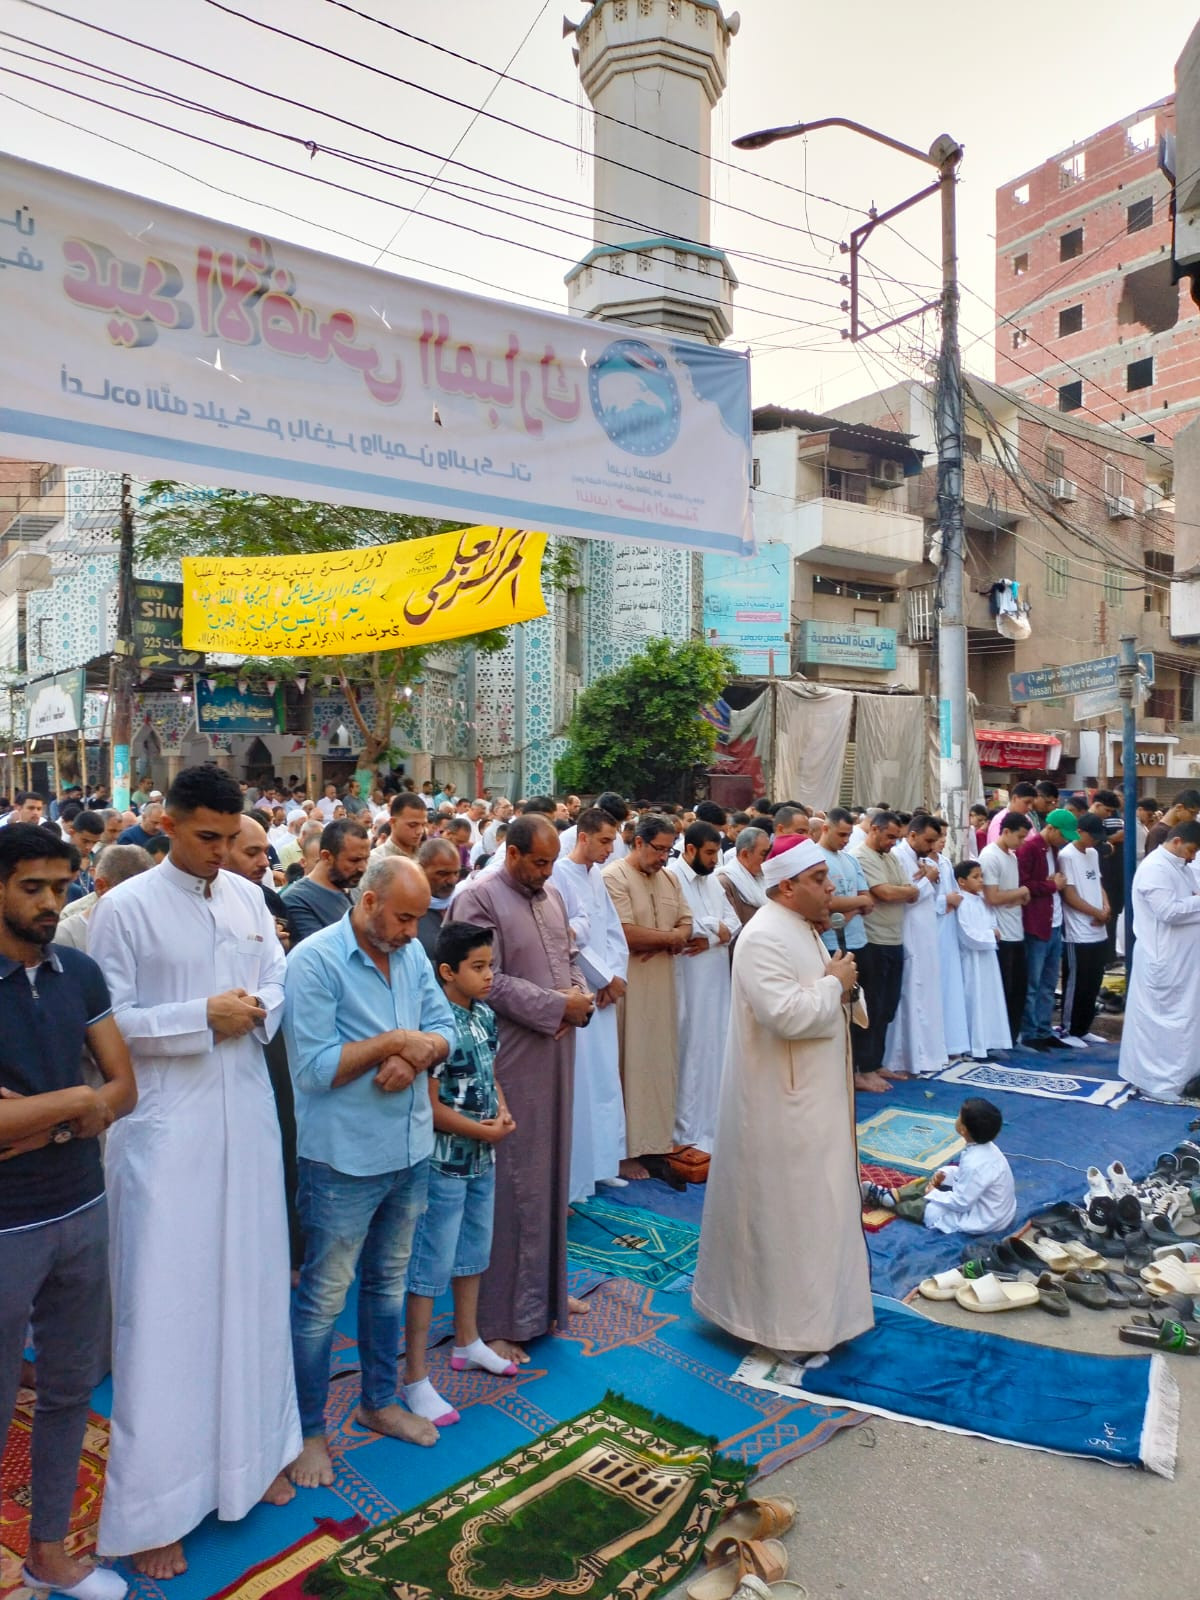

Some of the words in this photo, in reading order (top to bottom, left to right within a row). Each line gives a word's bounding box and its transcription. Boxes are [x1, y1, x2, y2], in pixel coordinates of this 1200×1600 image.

[143, 636, 162, 649] 925
[852, 635, 876, 650] الحياة
[1029, 684, 1052, 697] Hassan
